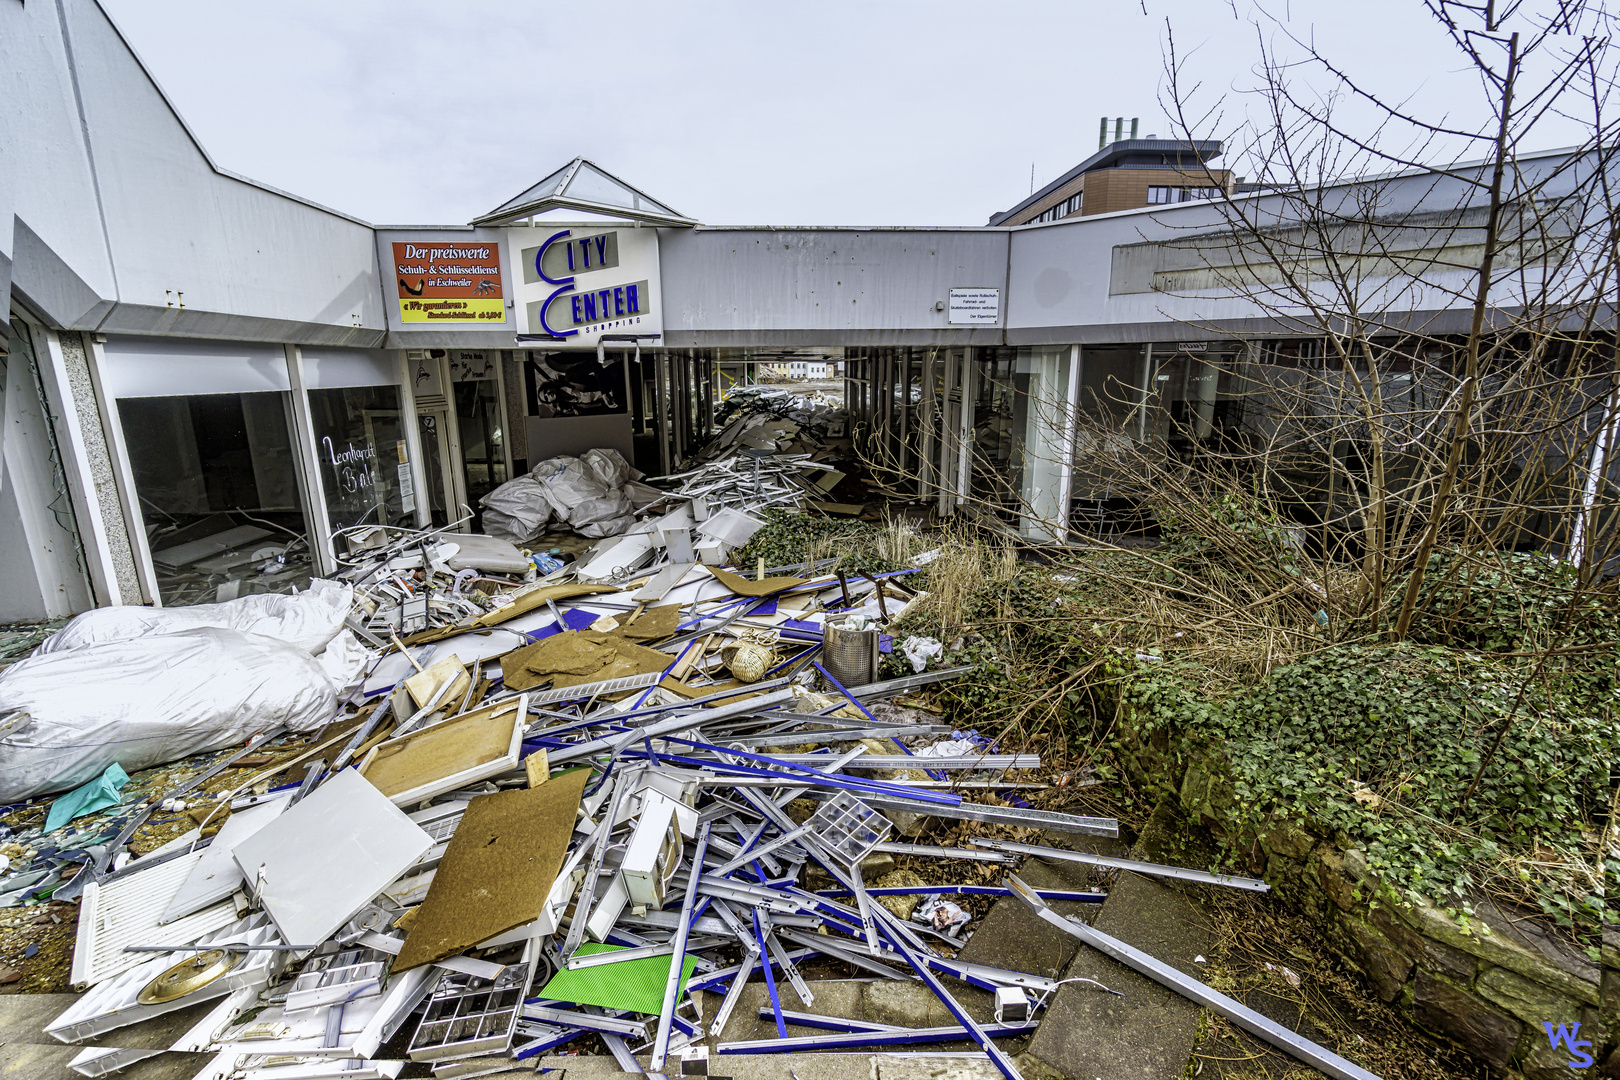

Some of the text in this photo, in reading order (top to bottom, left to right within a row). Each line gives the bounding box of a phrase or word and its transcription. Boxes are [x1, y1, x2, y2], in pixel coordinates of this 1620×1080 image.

[404, 244, 490, 263] Der preiswerte
[535, 229, 607, 285] CITY
[398, 265, 499, 275] Schuh- & Schlüsseldienst
[428, 278, 473, 287] in Eschweiler
[540, 284, 640, 337] CENTER
[585, 317, 641, 333] SHOPPING
[426, 418, 432, 426] 7
